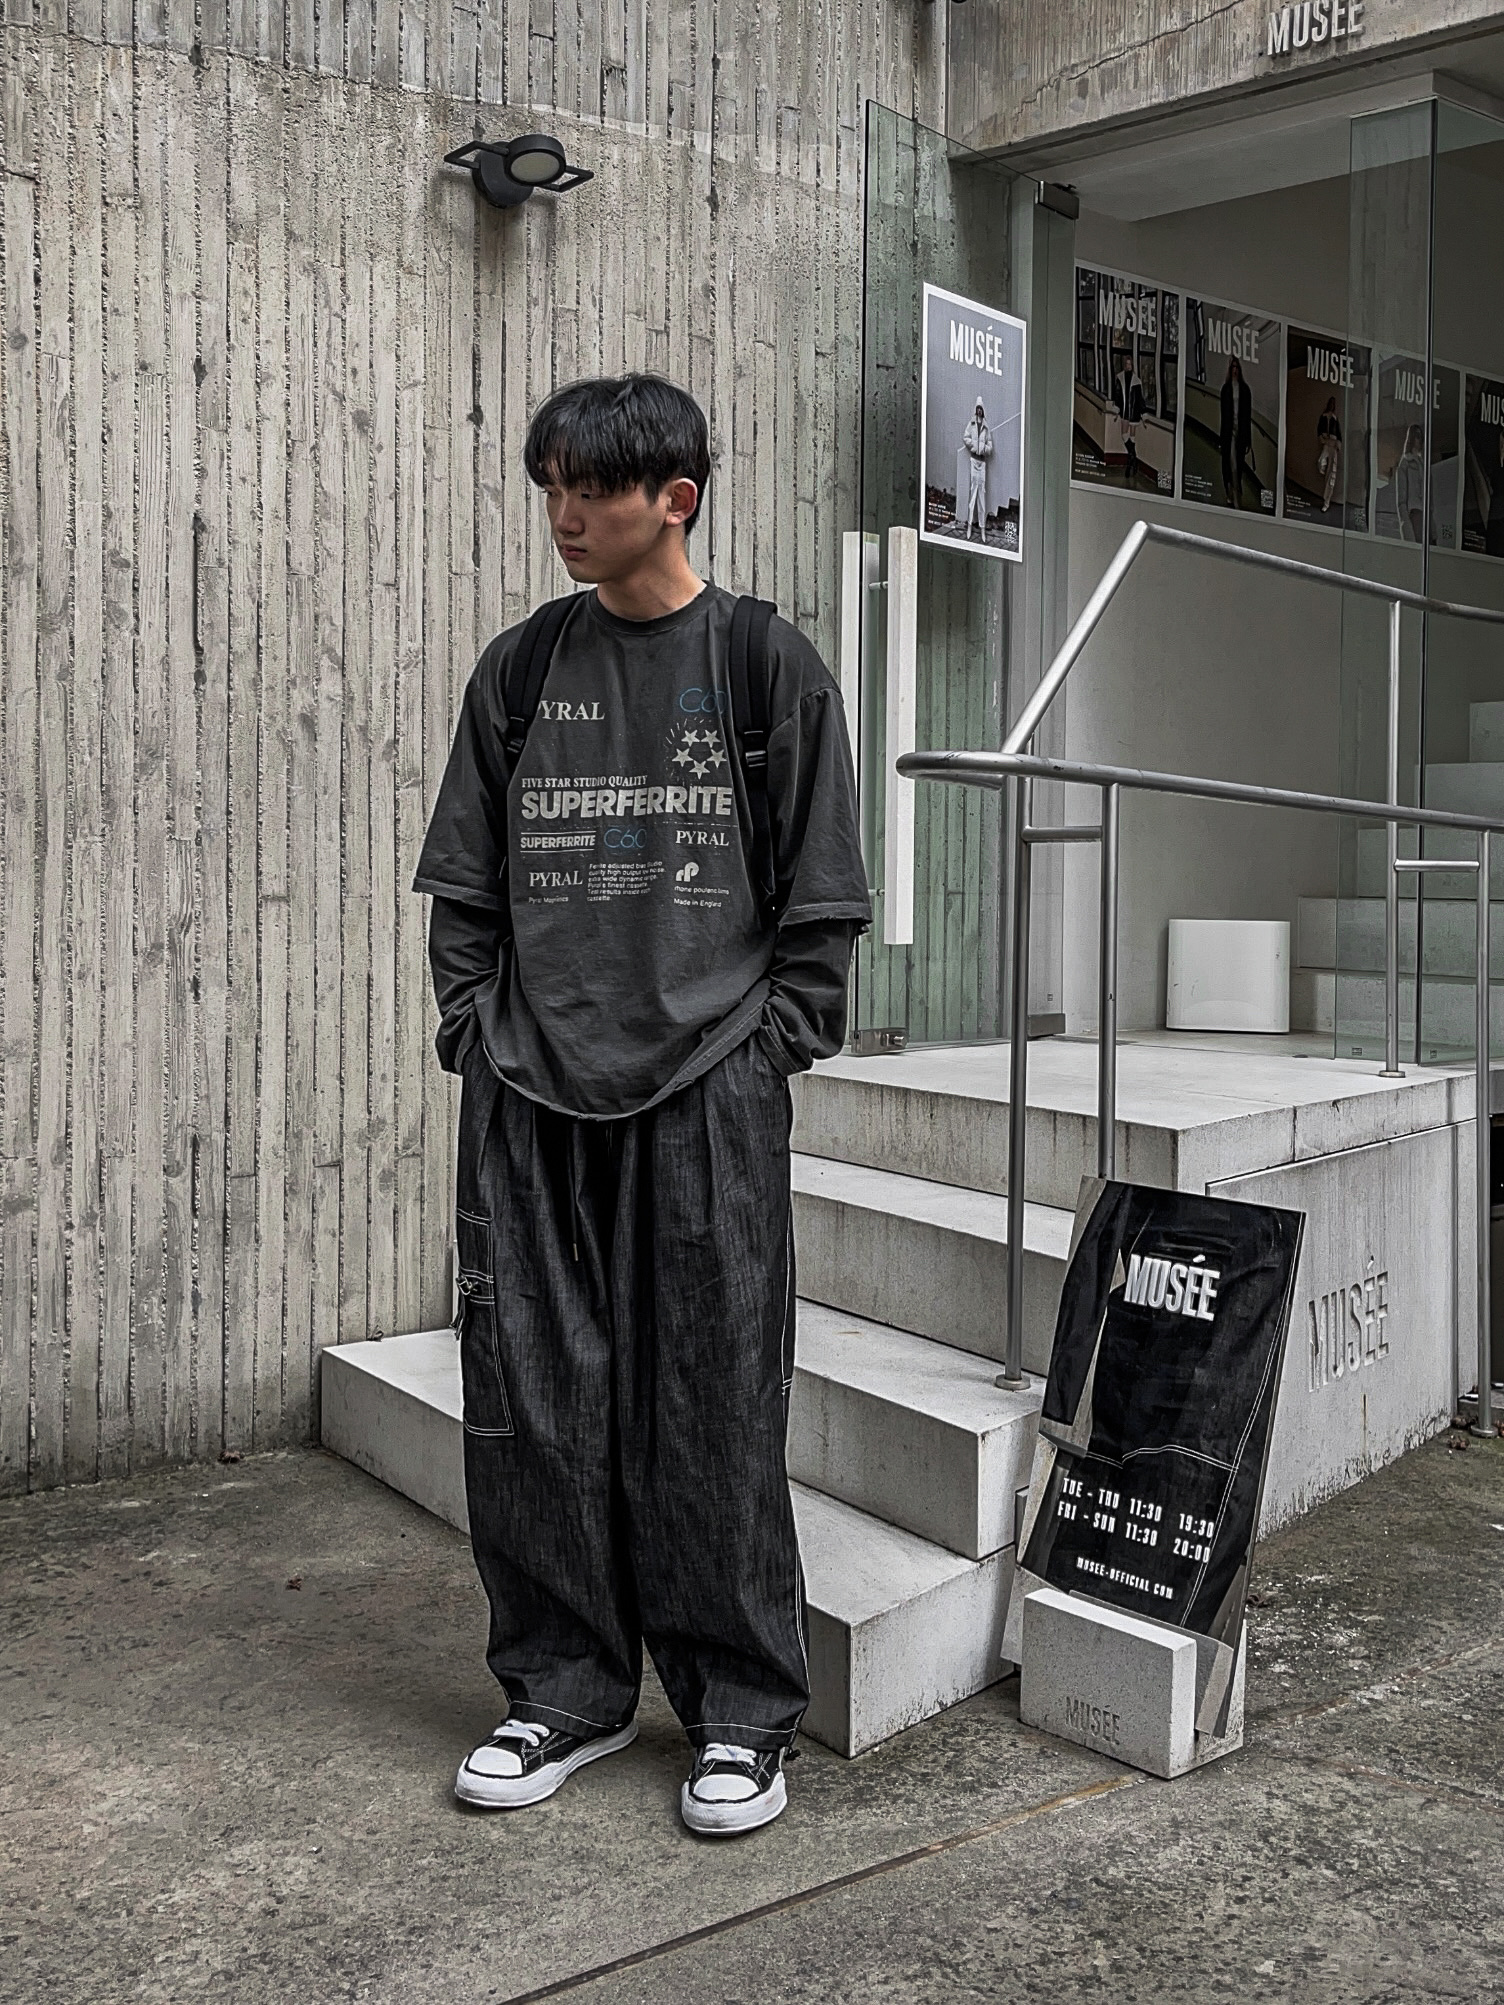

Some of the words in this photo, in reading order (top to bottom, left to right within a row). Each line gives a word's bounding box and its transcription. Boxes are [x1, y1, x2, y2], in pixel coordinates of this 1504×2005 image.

[1099, 289, 1157, 338] MUSÉE
[950, 319, 1003, 376] MUSÉE
[1208, 317, 1260, 364] MUSÉE
[1306, 345, 1354, 389] MUSÉE
[1394, 369, 1440, 409] MUSE
[537, 700, 606, 720] YRAL
[521, 777, 543, 788] FIVE
[544, 777, 571, 788] STAR
[573, 776, 606, 788] STUDIO
[608, 774, 648, 787] QUALITY
[521, 785, 733, 819] SUPERFERRITE
[520, 834, 596, 849] SUPERFERRITE
[675, 830, 730, 846] PYRAL
[529, 870, 584, 887] PYRAL
[673, 898, 691, 906] Made
[1123, 1254, 1220, 1321] MUSÉE
[1308, 1255, 1389, 1393] MUSÉE
[1062, 1477, 1083, 1498] TUE
[1098, 1488, 1120, 1509] THU
[1129, 1498, 1162, 1522] 11:30
[1179, 1513, 1214, 1538] 19:30
[1057, 1500, 1077, 1520] FRI
[1093, 1512, 1116, 1533] SUN
[1125, 1522, 1158, 1546] 11:30
[1173, 1538, 1211, 1563] 20:00
[1065, 1696, 1120, 1746] MUSÉE
